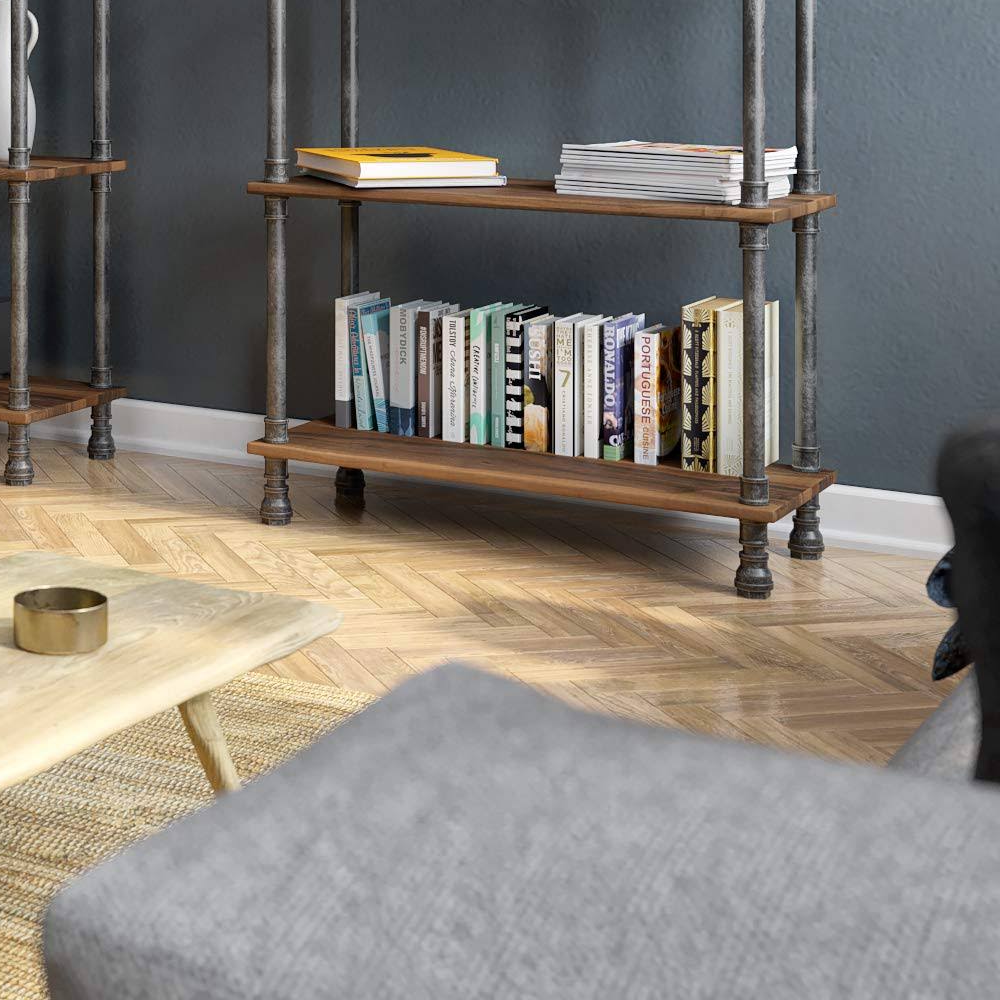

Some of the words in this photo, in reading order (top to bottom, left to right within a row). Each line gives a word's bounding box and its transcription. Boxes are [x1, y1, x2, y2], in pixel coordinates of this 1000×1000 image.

[449, 320, 457, 347] TOLSTOY
[556, 338, 571, 347] ME
[449, 350, 457, 378] Anna
[472, 345, 481, 374] CREATIVE
[603, 325, 616, 407] RONALDO
[559, 369, 571, 388] 7
[641, 336, 651, 424] PORTUGUESE
[447, 381, 457, 427] Karenina
